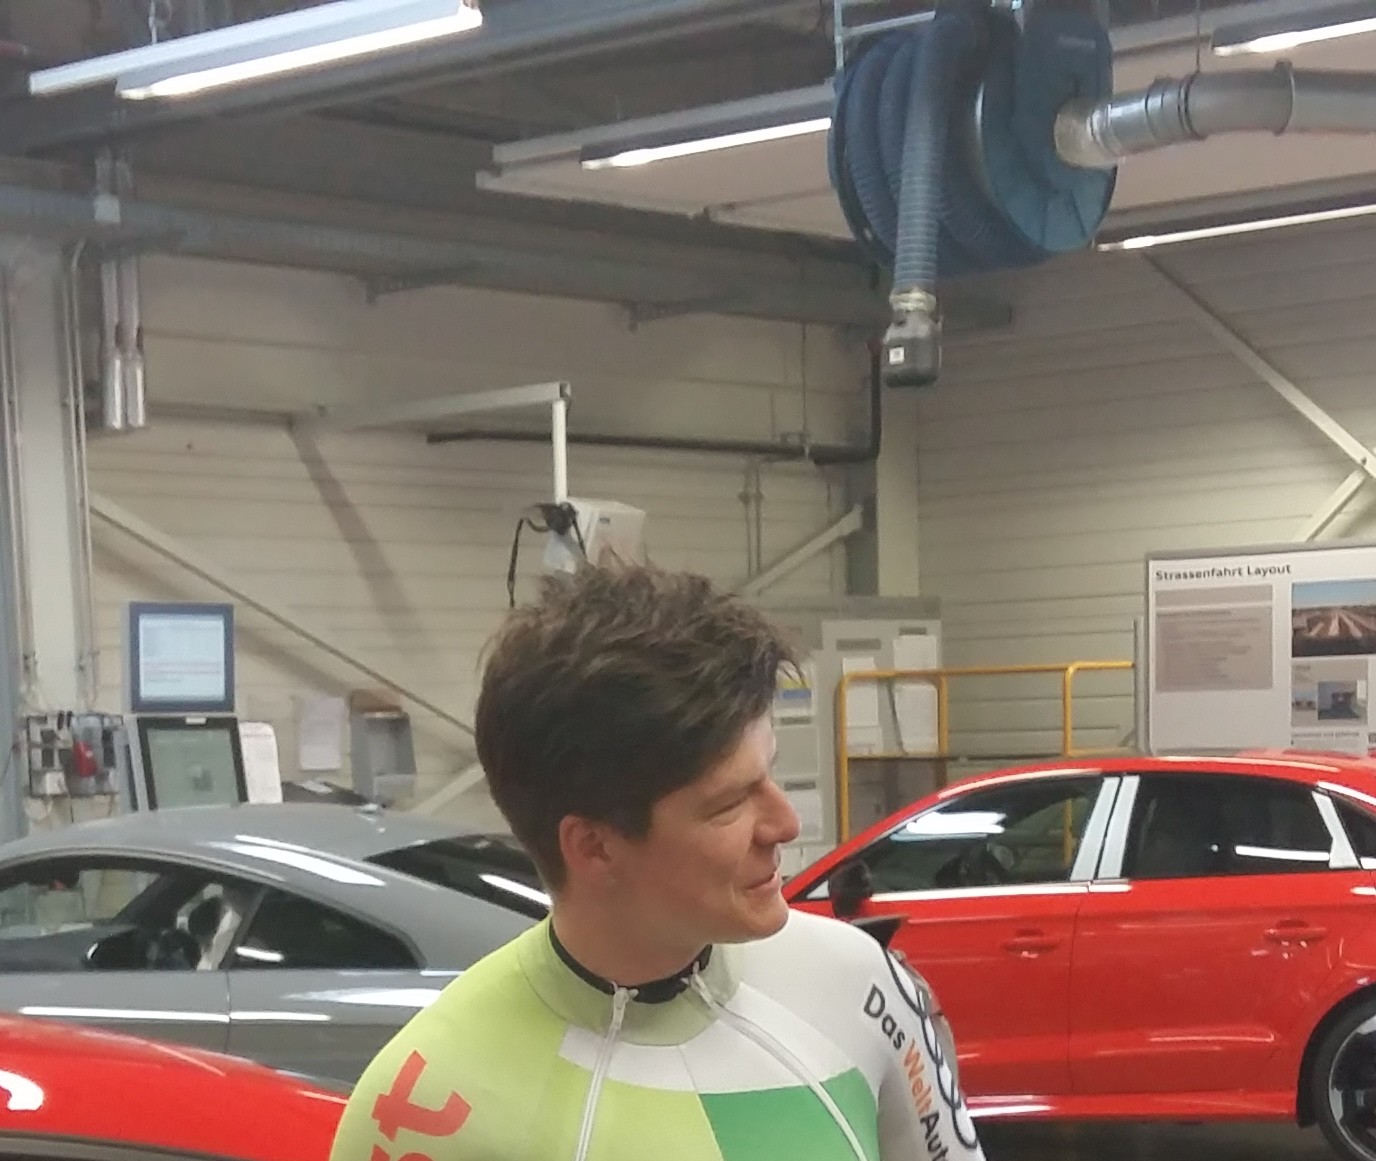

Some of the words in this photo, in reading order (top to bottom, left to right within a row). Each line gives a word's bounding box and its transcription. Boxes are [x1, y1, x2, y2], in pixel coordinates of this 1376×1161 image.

[1155, 567, 1243, 581] Strassenfahrt
[1247, 564, 1292, 577] Layout
[863, 983, 906, 1050] Das
